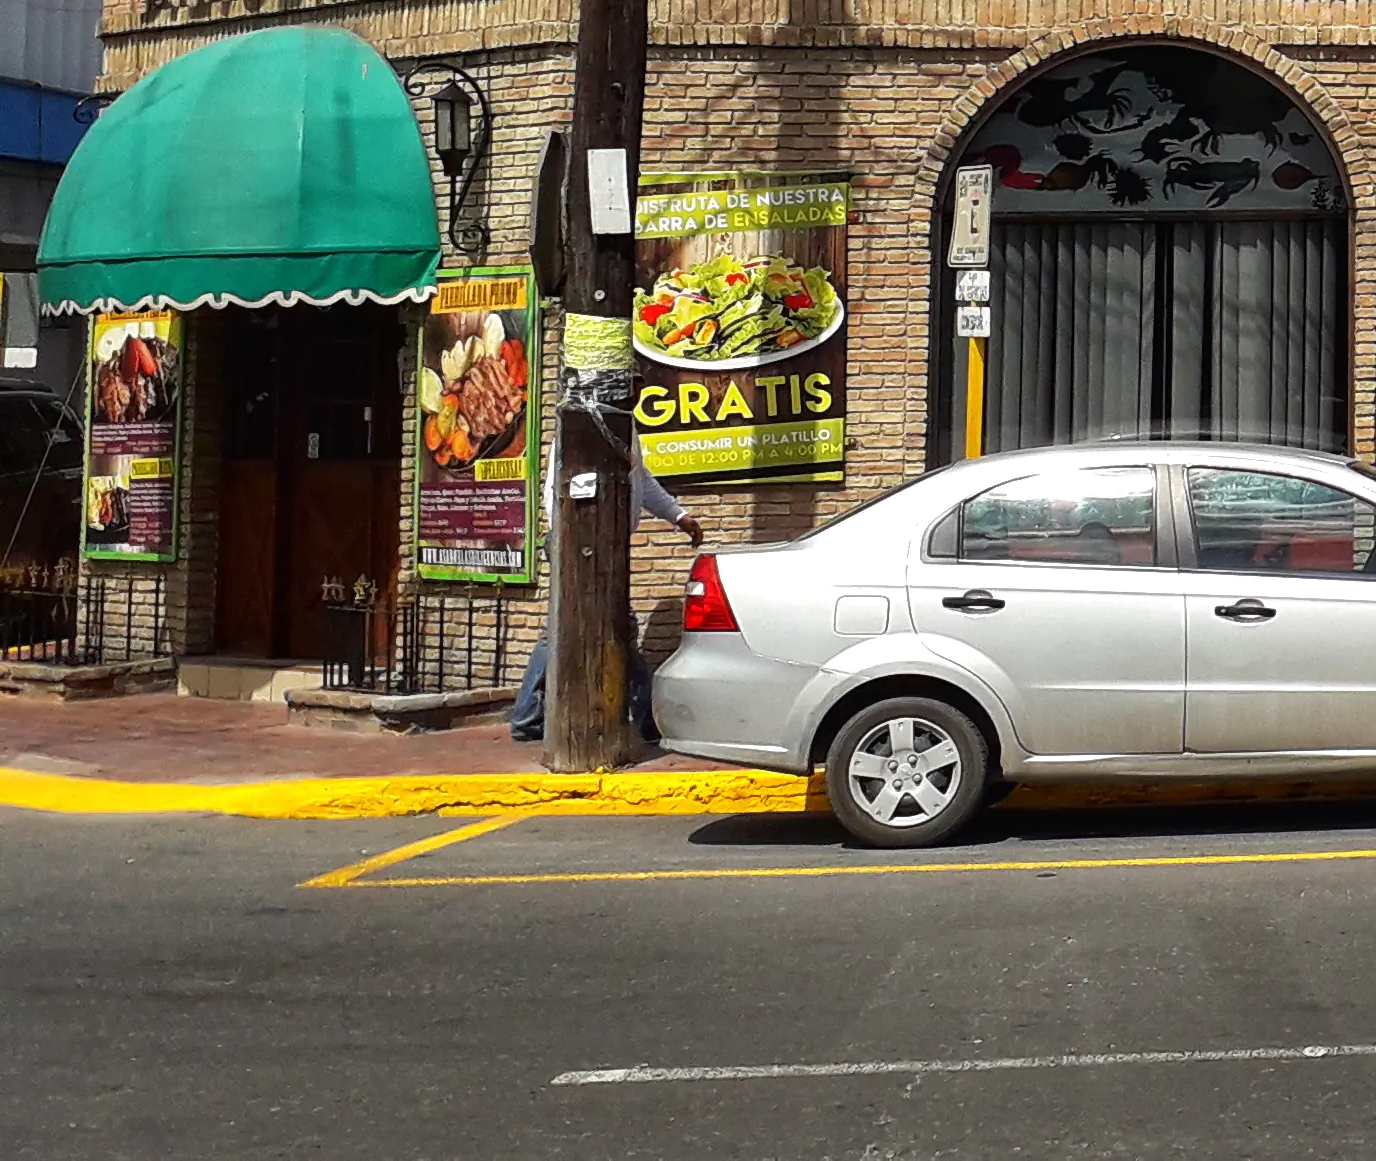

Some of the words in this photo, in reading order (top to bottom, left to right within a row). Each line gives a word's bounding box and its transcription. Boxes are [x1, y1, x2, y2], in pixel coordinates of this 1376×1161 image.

[727, 193, 749, 208] DE
[757, 188, 844, 207] NUESTRA
[705, 213, 728, 229] DE
[733, 205, 846, 227] ENSALADAS
[632, 372, 833, 427] GRATIS
[656, 437, 733, 454] CONSUMIR
[737, 435, 758, 447] UN
[762, 428, 831, 446] PLATILLO
[680, 454, 696, 465] DE
[702, 451, 738, 464] 12:00
[821, 442, 842, 454] PM
